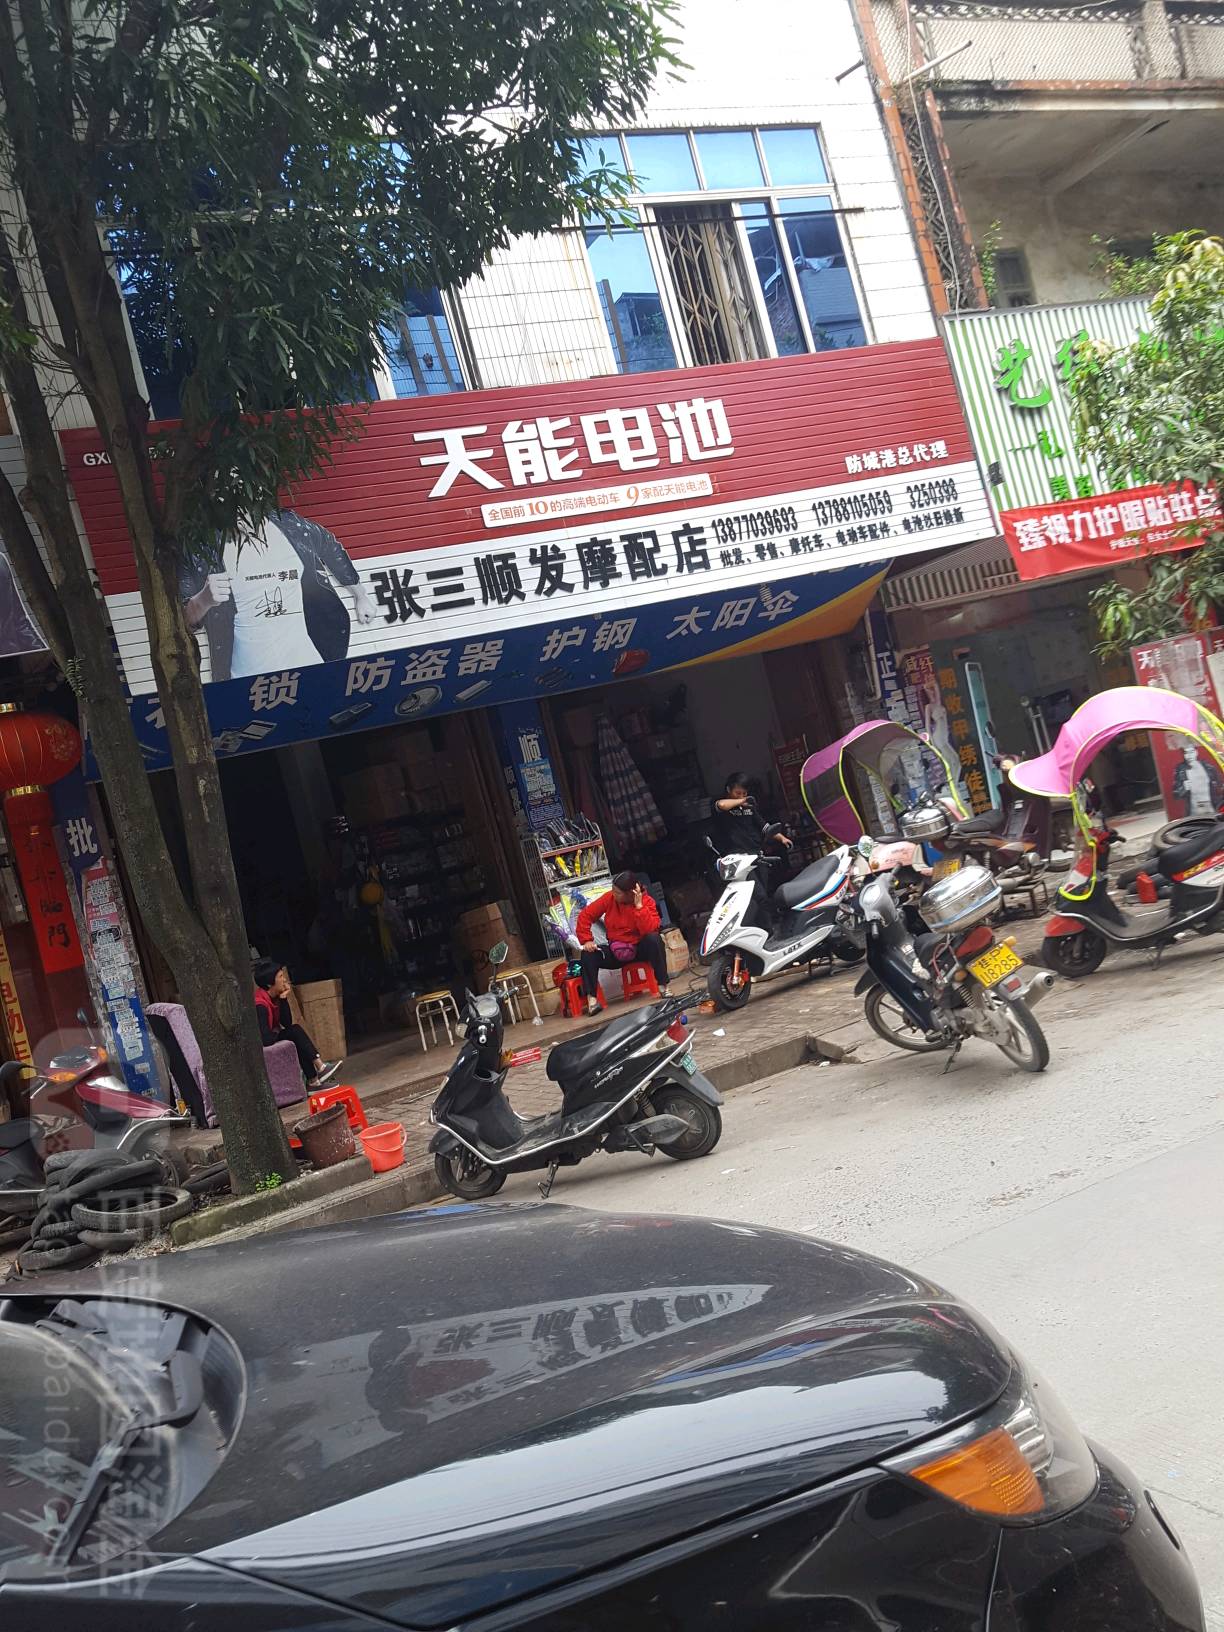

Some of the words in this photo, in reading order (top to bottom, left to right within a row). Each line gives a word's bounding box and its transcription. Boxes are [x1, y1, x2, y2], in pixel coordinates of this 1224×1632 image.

[412, 397, 735, 498] 天能电池
[845, 440, 949, 474] 防城港总代理
[488, 492, 621, 522] 全国前10的高端电动车
[711, 506, 799, 545] 13877039693
[811, 490, 893, 527] 13788105059
[278, 569, 299, 582] 李晨
[370, 522, 712, 624] 张三顺发摩配店
[248, 672, 299, 713] 锁
[345, 638, 505, 697] 防盗器
[538, 617, 636, 663] 护钢
[666, 590, 800, 641] 太阳伞
[66, 817, 98, 857] 批
